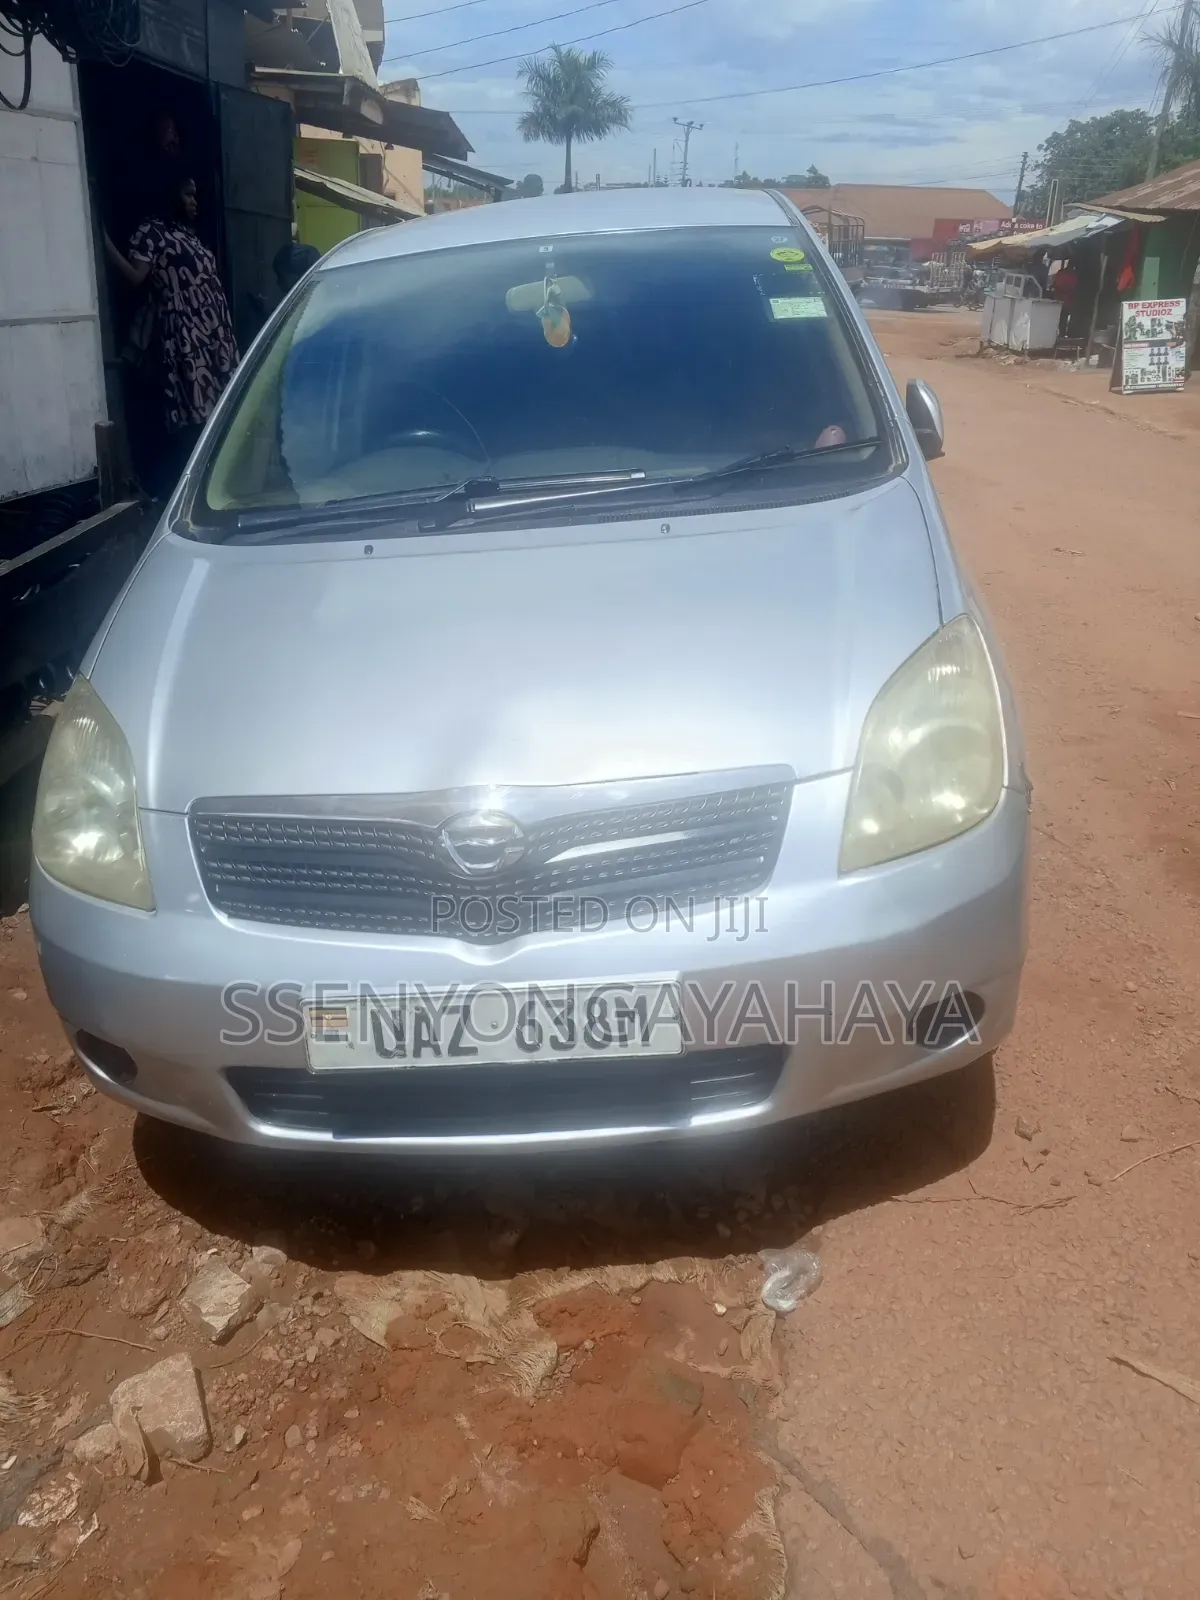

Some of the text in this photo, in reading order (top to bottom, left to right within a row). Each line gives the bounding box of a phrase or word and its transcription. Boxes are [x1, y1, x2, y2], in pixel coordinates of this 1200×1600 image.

[1036, 222, 1043, 230] to
[1135, 309, 1173, 317] STUDIOZ
[369, 994, 652, 1059] UAZ 638M
